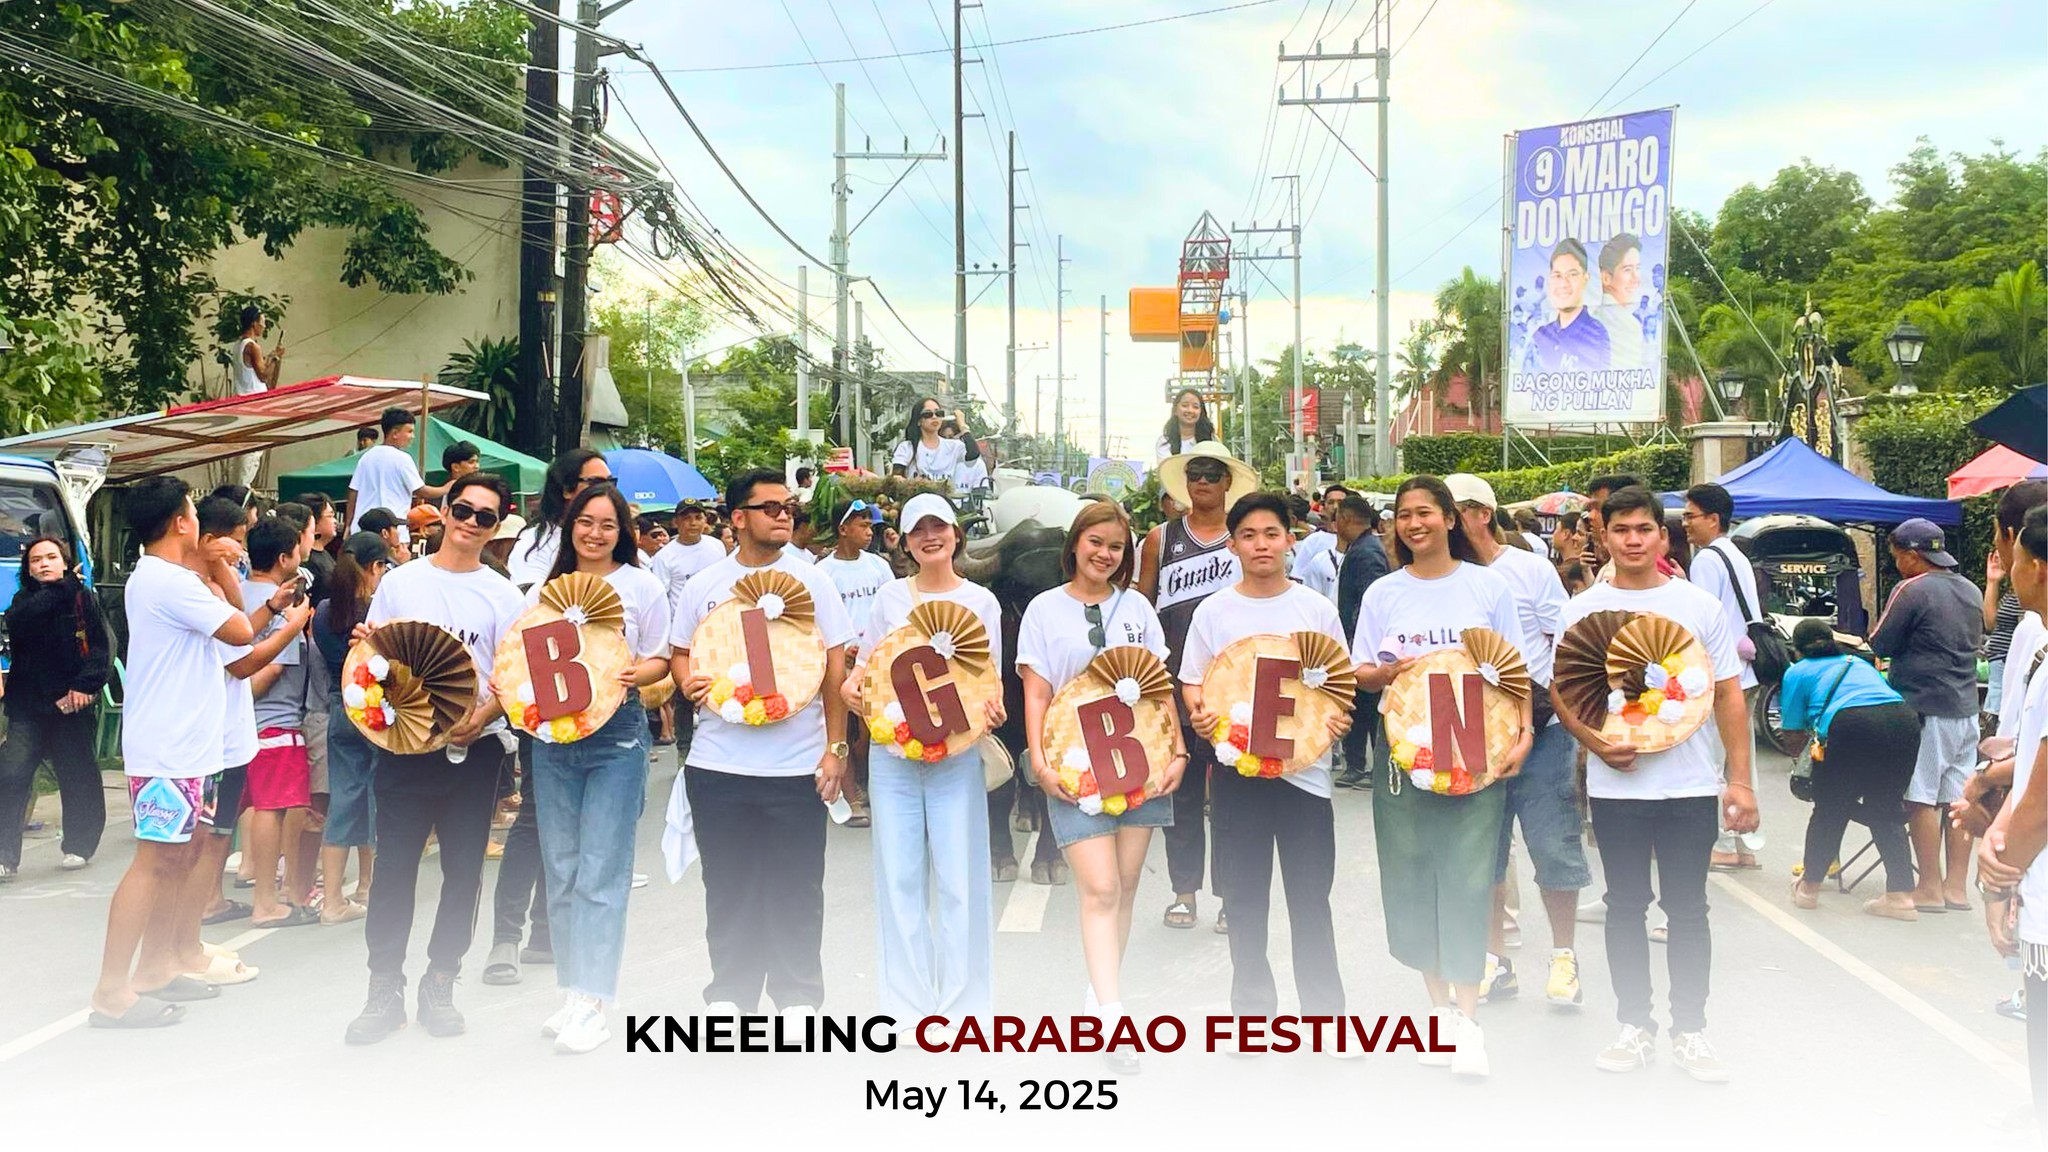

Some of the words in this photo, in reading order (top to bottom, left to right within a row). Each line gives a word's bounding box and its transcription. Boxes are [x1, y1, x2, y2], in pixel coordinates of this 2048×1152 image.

[1560, 118, 1626, 147] KONSEHAL
[1535, 151, 1554, 192] 9
[1564, 135, 1659, 195] MARO
[1517, 184, 1665, 249] DOMINGO
[1513, 371, 1588, 393] BAGONG
[1590, 368, 1655, 392] MUKHA
[1531, 391, 1560, 412] NG
[1561, 389, 1633, 411] PULILAN
[634, 491, 656, 500] BDO
[1780, 564, 1828, 574] SERVICE
[521, 619, 593, 721] B
[890, 645, 970, 745] G
[1250, 656, 1300, 759] E
[1429, 672, 1488, 773] N
[1077, 694, 1150, 799] B
